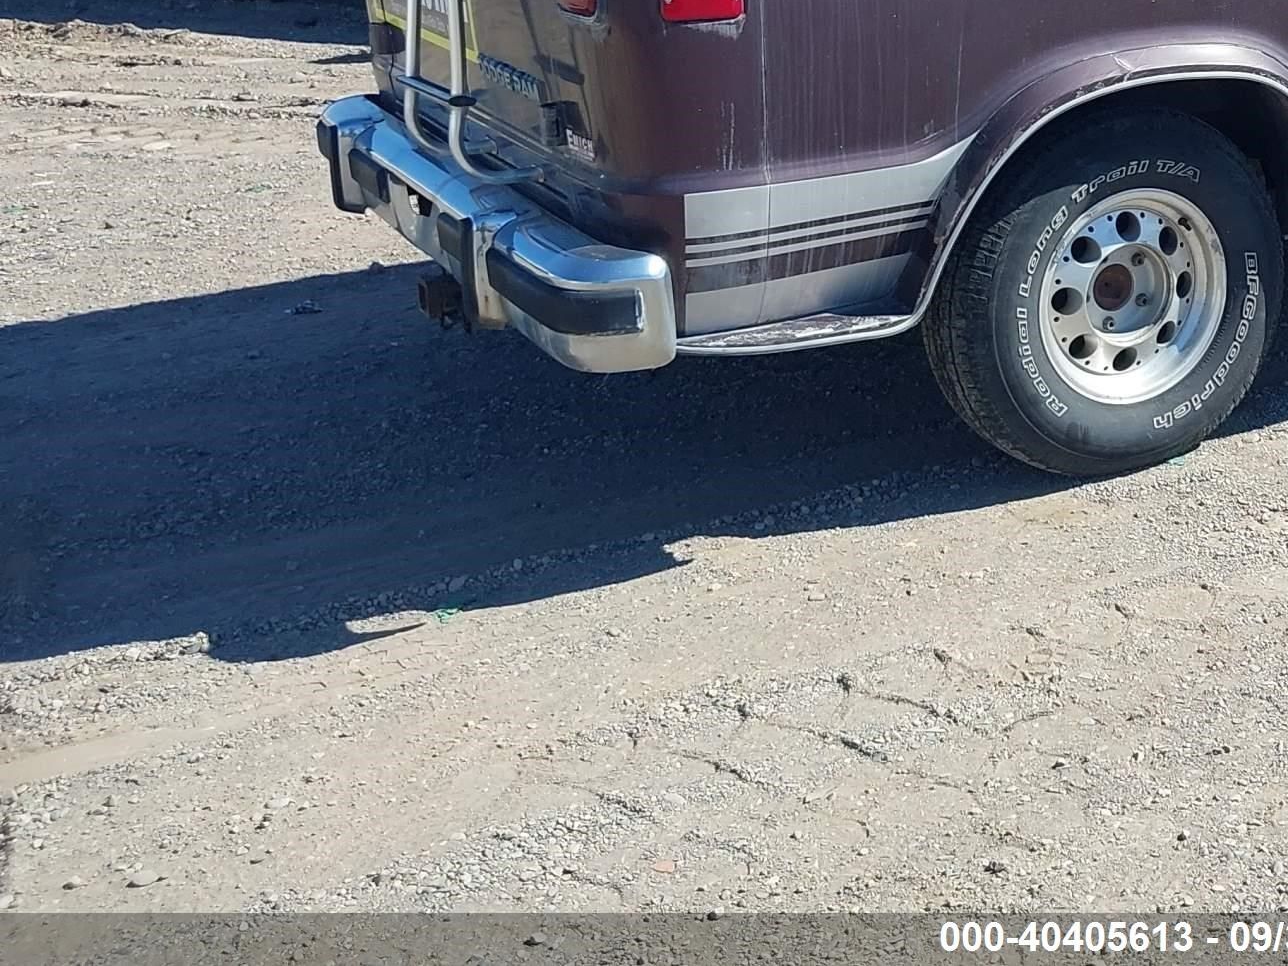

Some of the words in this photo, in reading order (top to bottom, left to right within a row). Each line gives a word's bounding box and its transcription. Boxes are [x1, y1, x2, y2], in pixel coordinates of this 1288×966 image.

[1071, 159, 1150, 204] Trail
[1156, 159, 1201, 184] T/A
[1018, 205, 1069, 298] Long
[1015, 307, 1069, 418] Radial
[1152, 251, 1260, 430] BFGoodrich
